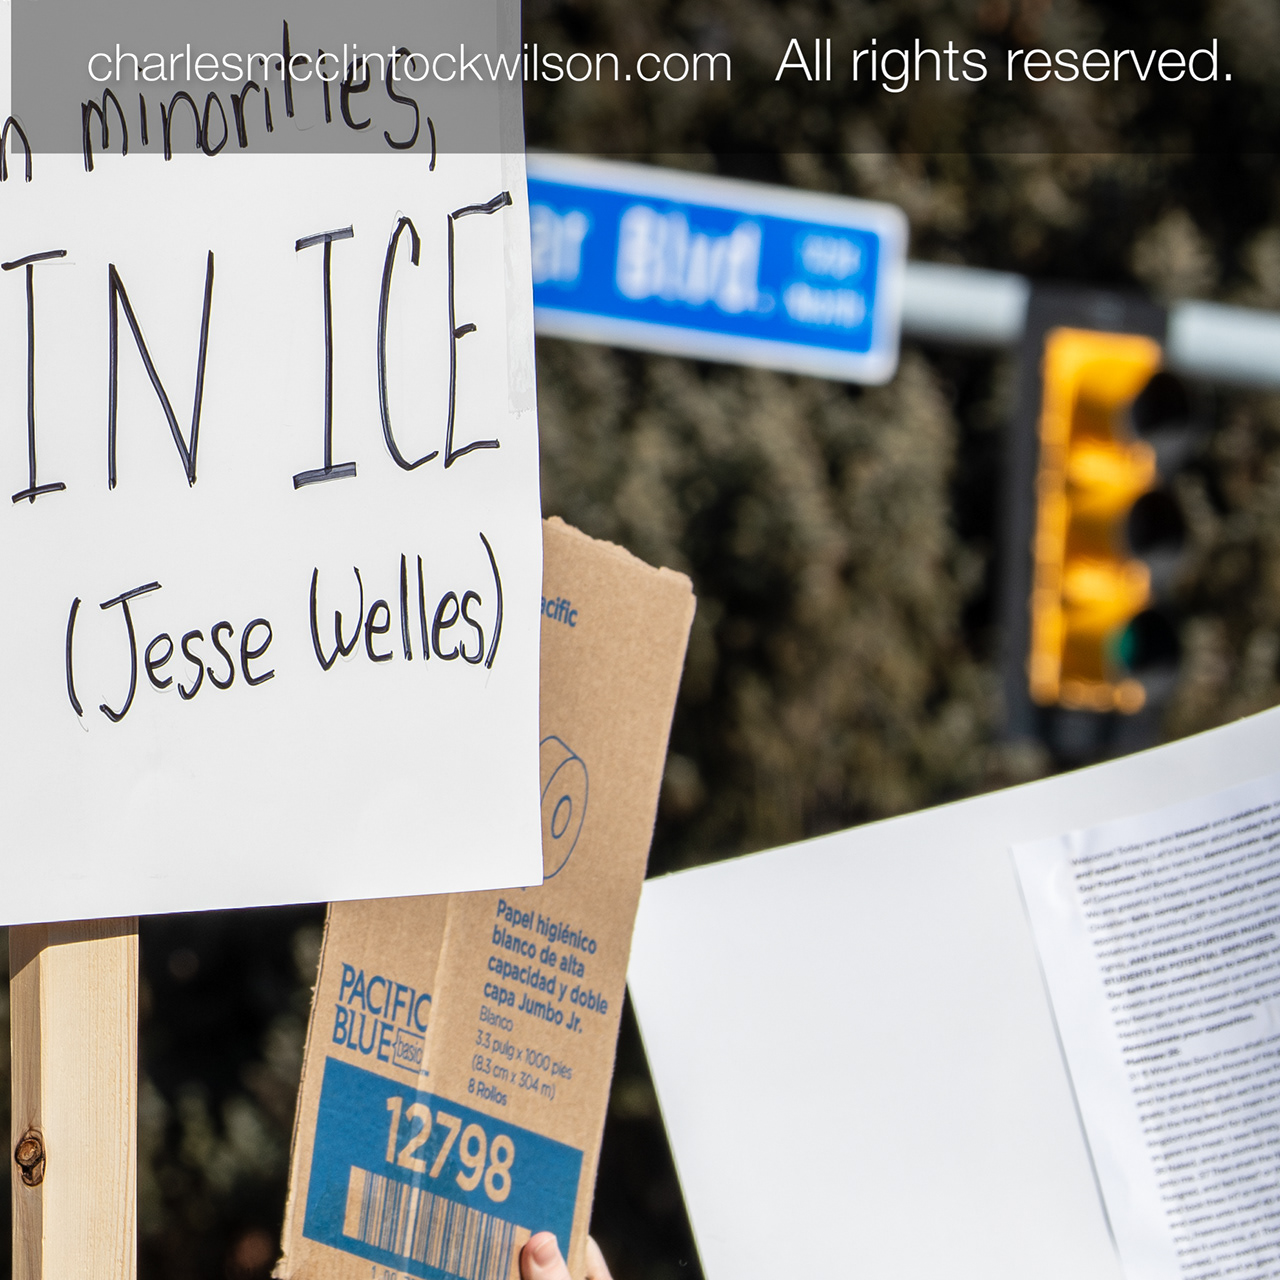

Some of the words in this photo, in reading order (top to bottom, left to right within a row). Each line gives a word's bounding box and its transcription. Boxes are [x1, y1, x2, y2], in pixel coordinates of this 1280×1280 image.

[80, 19, 437, 173] minorities,
[293, 191, 513, 489] ICE
[65, 580, 276, 723] (Jesse
[308, 533, 503, 672] Welles)
[492, 924, 536, 959] blanco
[540, 945, 556, 967] de
[560, 954, 585, 978] alta
[496, 898, 534, 930] Papel
[536, 914, 596, 954] higiénico
[339, 962, 432, 1033] PACIFIC
[484, 982, 516, 1006] capa
[518, 993, 564, 1026] Jumbo
[566, 1012, 582, 1034] Jr.
[488, 955, 556, 995] capacidad
[558, 983, 568, 1002] y
[570, 985, 608, 1014] doble
[332, 1004, 394, 1063] BLUE
[479, 1005, 514, 1032] Blanco
[492, 1039, 515, 1061] pulg
[526, 1048, 550, 1072] 1000
[493, 1065, 508, 1082] cm
[518, 1072, 540, 1092] 304
[468, 1078, 476, 1094] 8
[477, 1081, 508, 1106] Rollos
[385, 1096, 516, 1202] 12798
